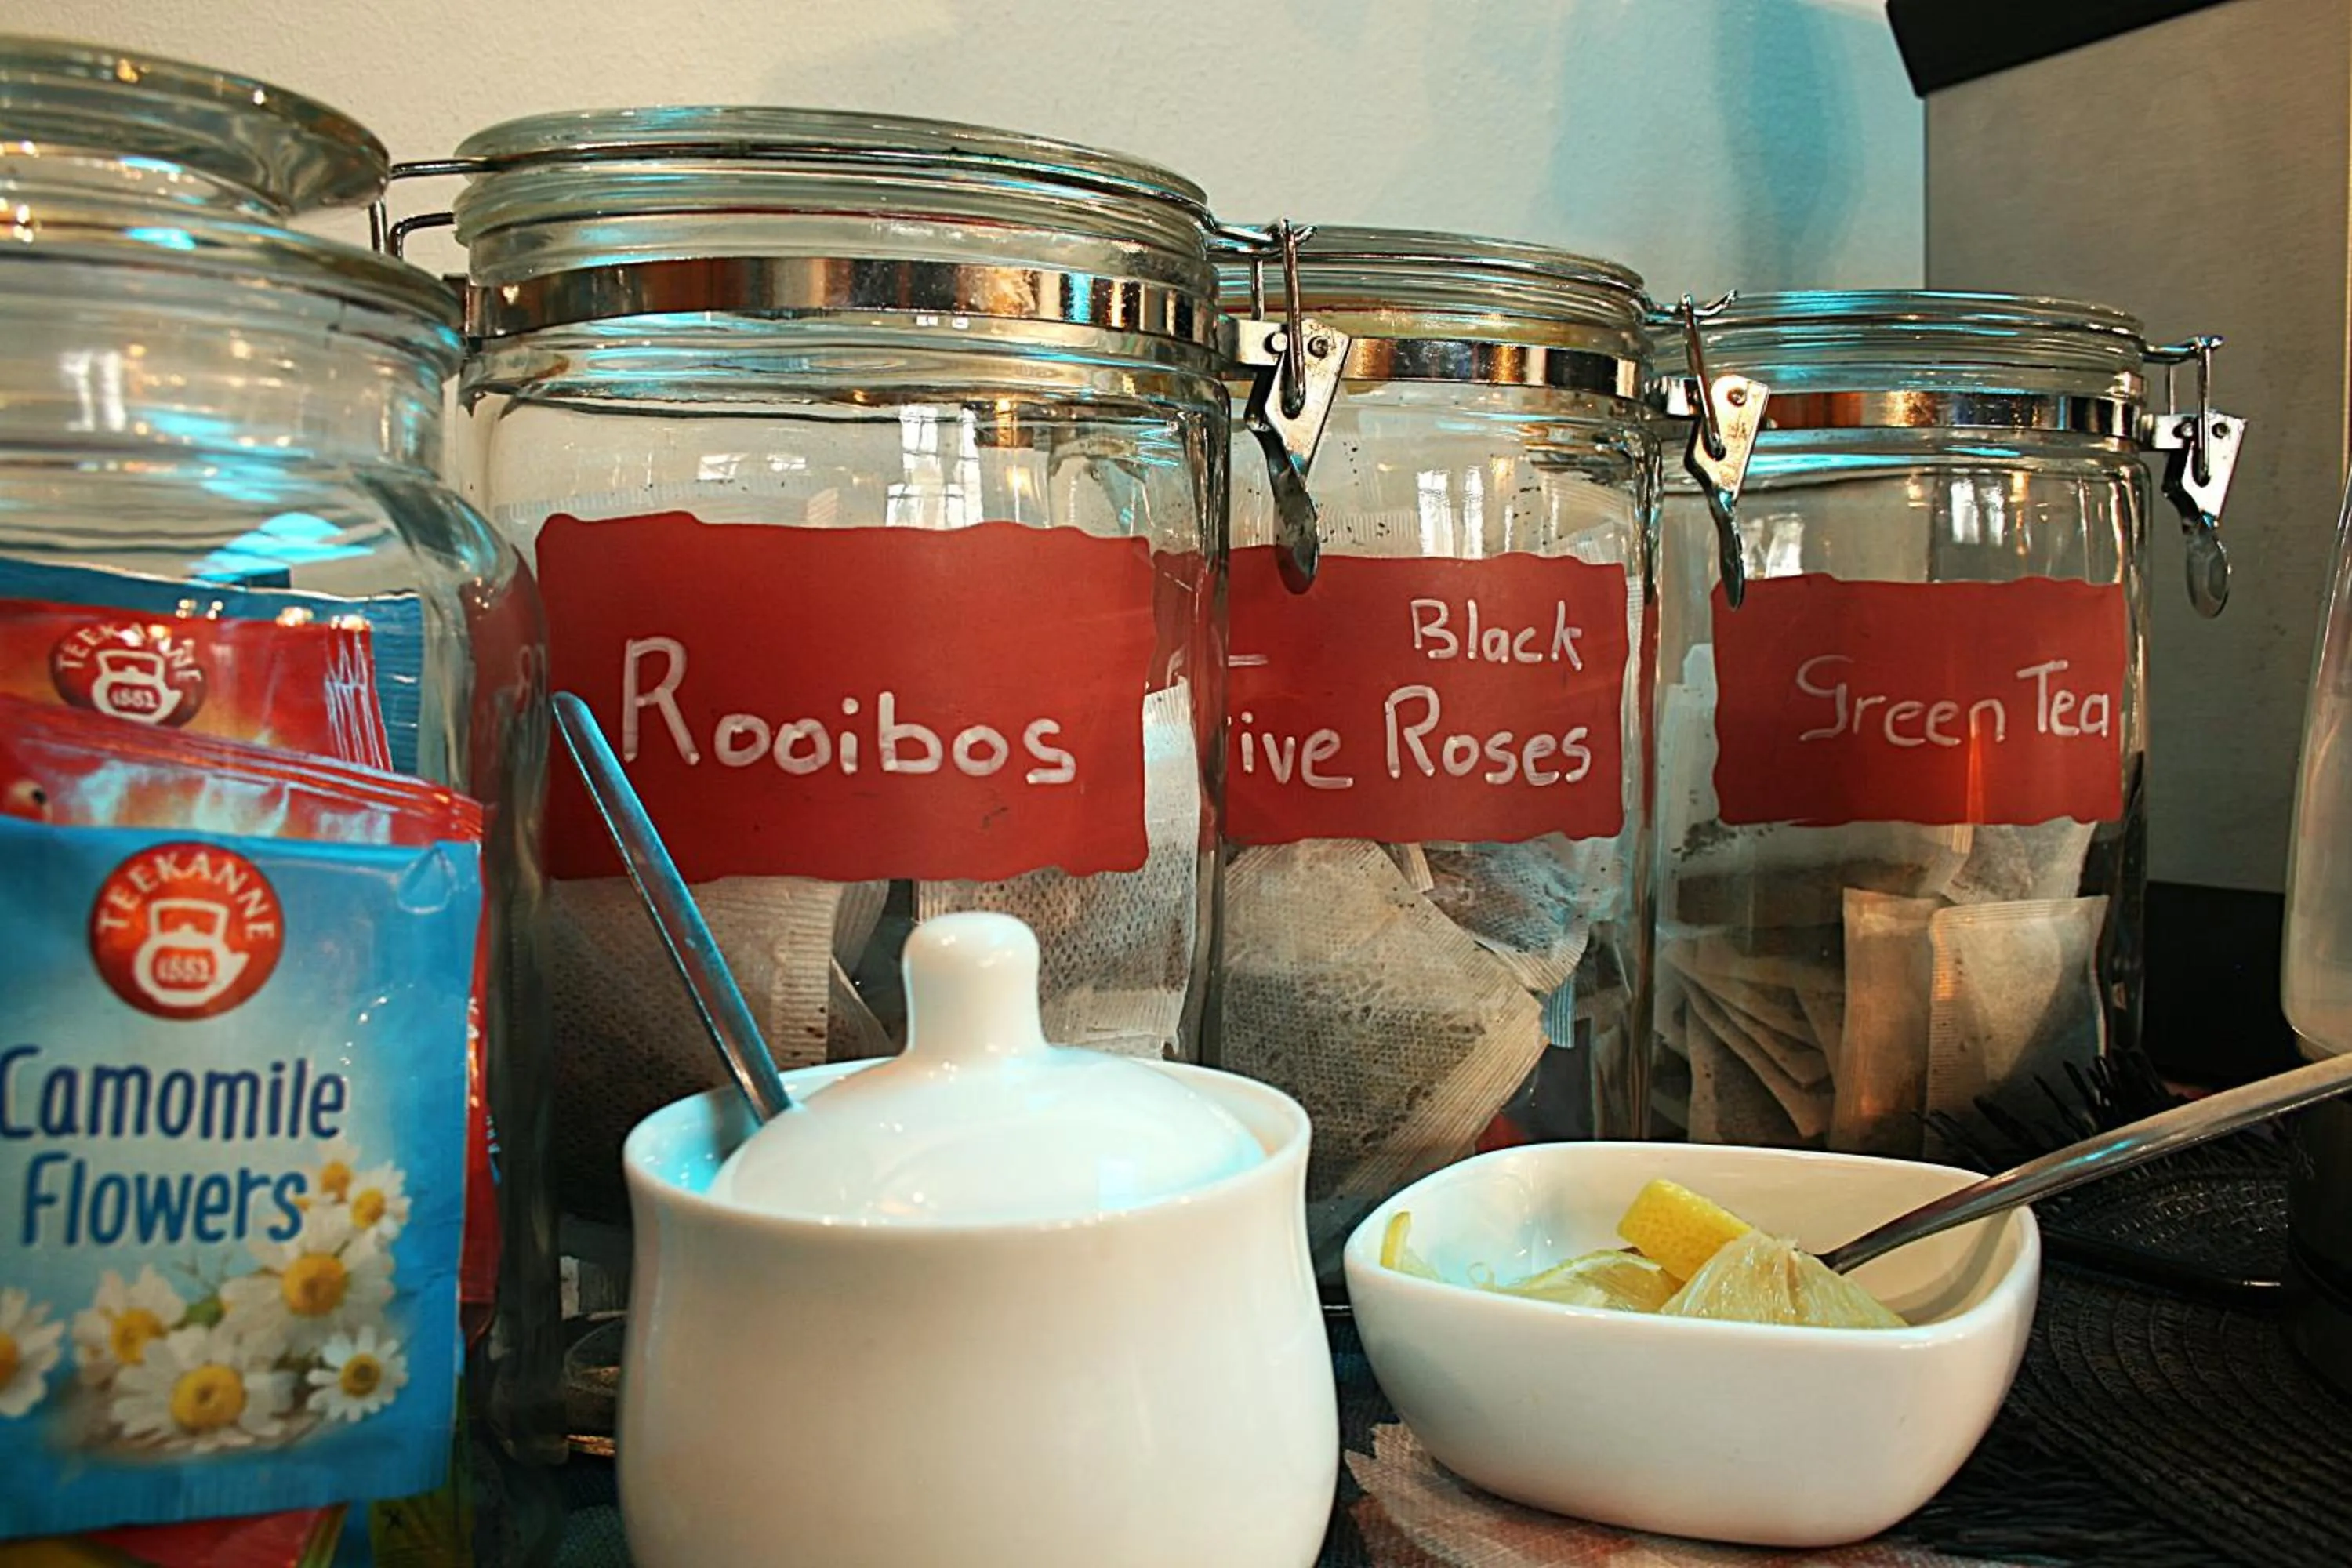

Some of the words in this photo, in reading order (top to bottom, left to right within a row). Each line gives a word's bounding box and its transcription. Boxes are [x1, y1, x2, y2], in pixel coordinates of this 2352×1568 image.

[1411, 598, 1582, 671] Black
[623, 636, 1076, 784] Rooibos
[1385, 685, 1592, 786] Roses
[1796, 654, 2006, 746] Green
[2016, 659, 2110, 737] Tea
[97, 852, 274, 940] TEEKANNE
[0, 1045, 346, 1140] Camomile
[22, 1151, 307, 1246] Flowers
